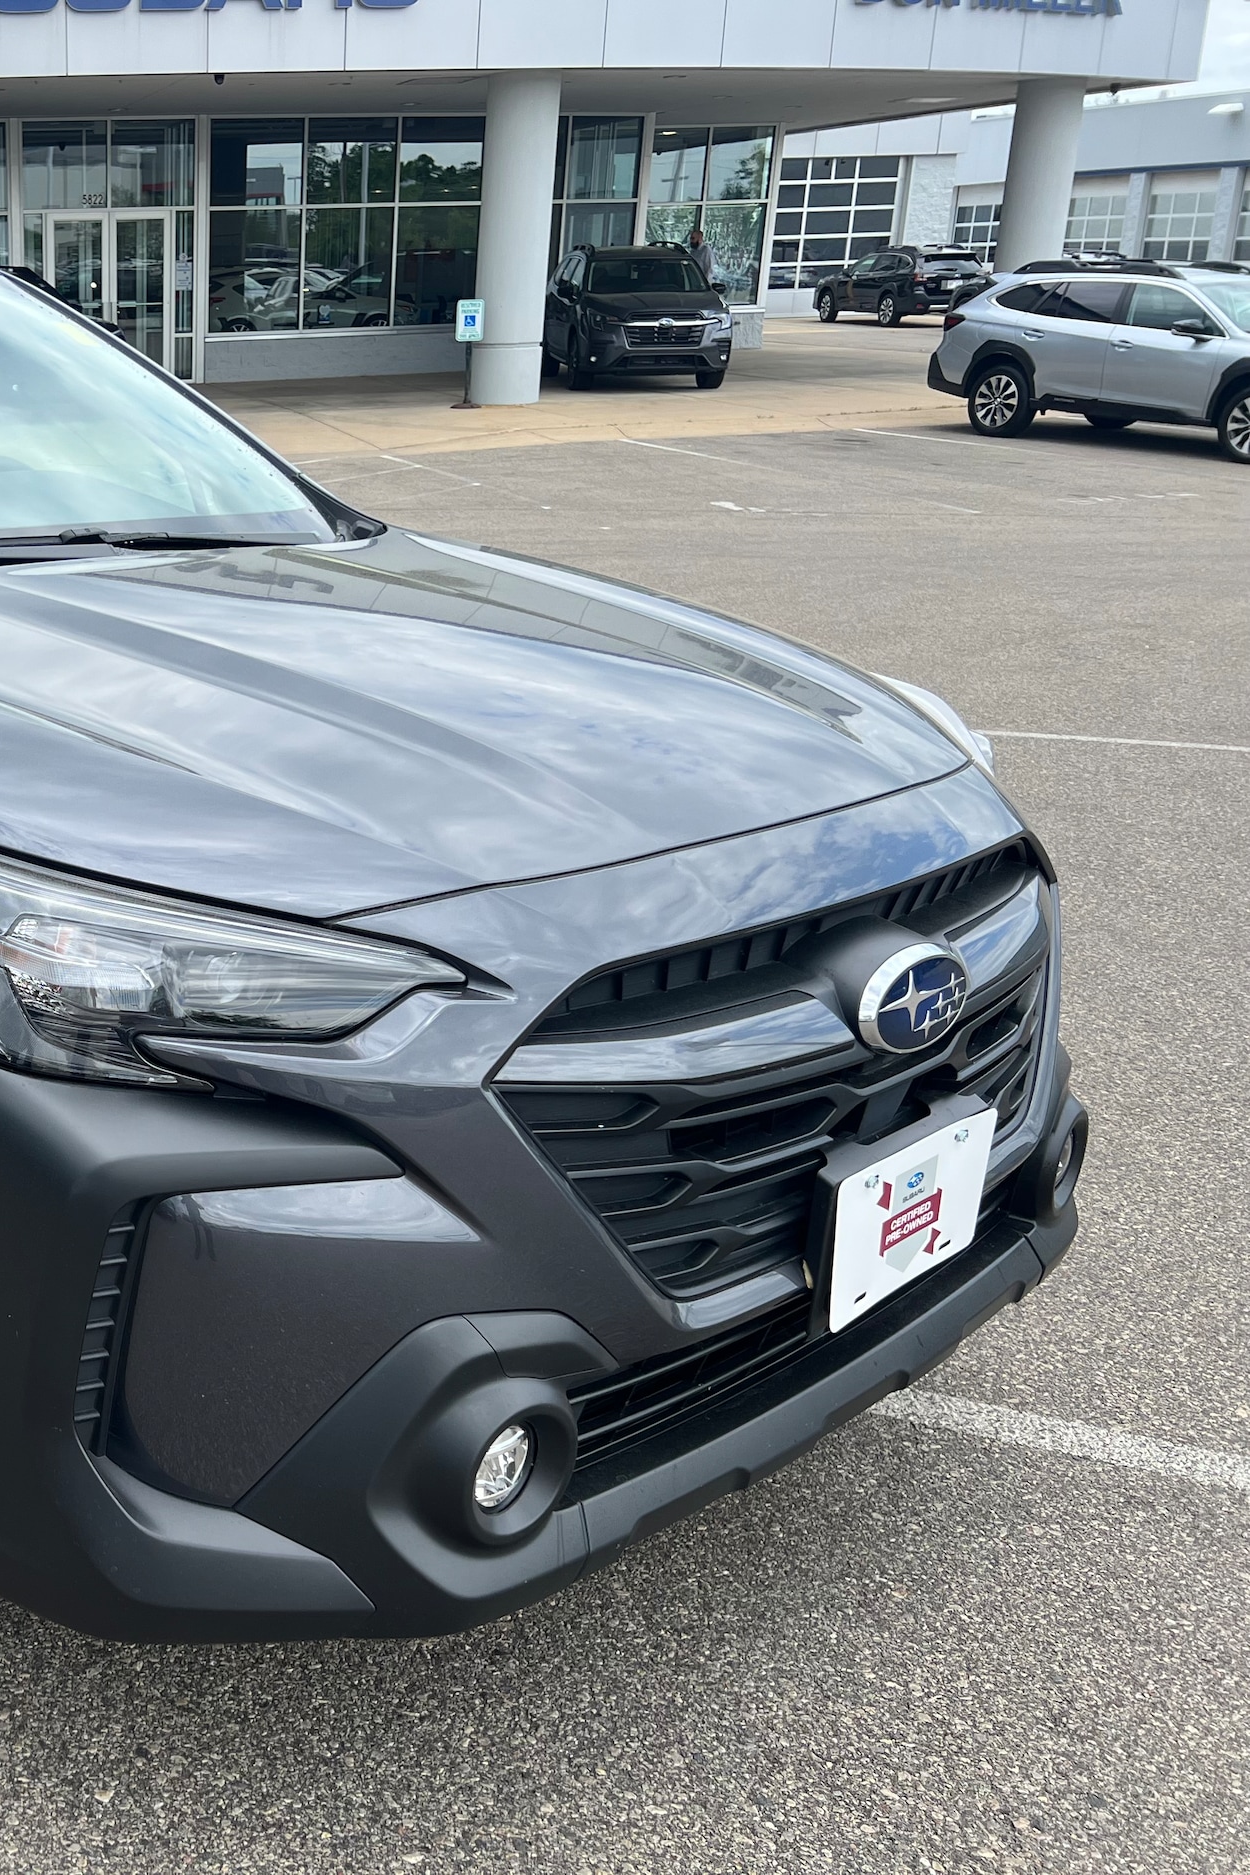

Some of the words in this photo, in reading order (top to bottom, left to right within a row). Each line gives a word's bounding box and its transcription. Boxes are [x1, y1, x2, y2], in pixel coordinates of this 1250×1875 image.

[81, 194, 104, 205] 5822
[903, 1187, 925, 1202] SUBARU
[891, 1201, 931, 1231] CERTIFIED
[885, 1212, 933, 1246] PRE-OWNED
